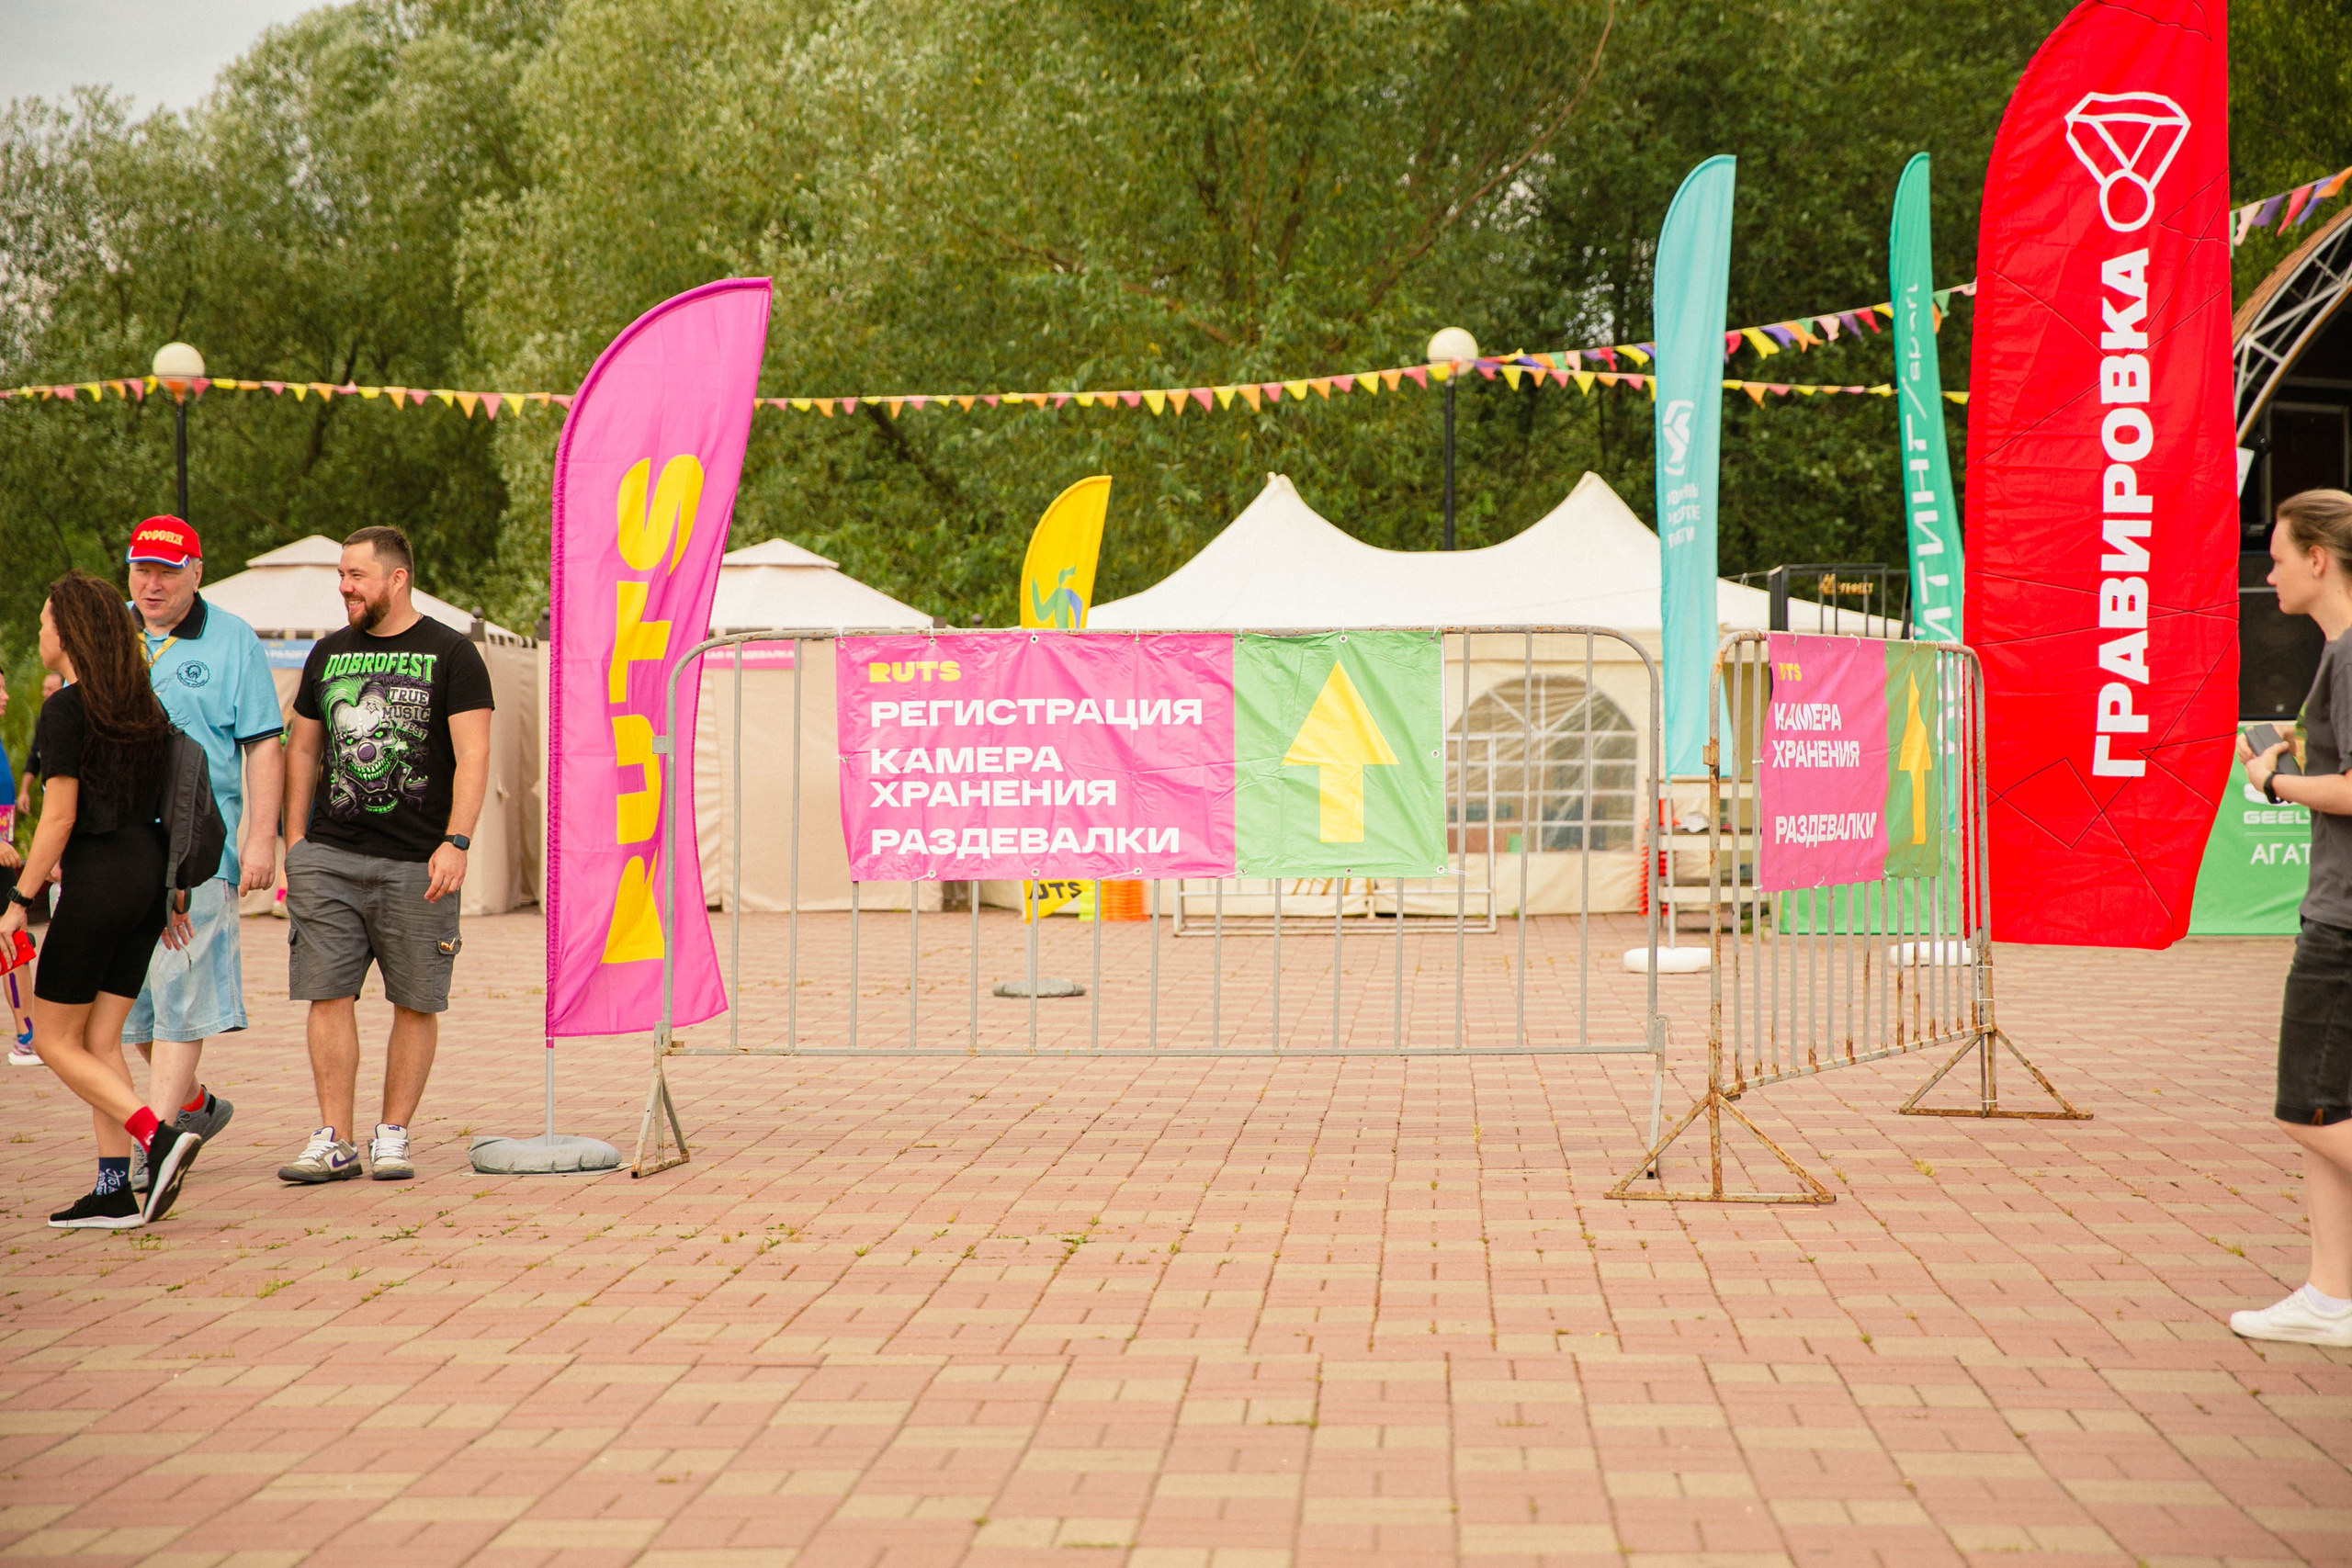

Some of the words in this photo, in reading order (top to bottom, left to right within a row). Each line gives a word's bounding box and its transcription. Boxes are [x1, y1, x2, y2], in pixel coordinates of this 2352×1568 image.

[2092, 248, 2154, 776] ГРАВИРОВКА
[136, 529, 184, 547] РОССИЯ
[321, 651, 437, 683] DOBROFEST
[868, 660, 962, 683] RUTS
[390, 687, 429, 705] TRUE
[382, 705, 431, 722] MUSIC
[870, 698, 1203, 731] РЕГИСТРАЦИЯ
[1774, 702, 1842, 731] КАМЕРА
[401, 721, 428, 739] FEST
[870, 746, 1064, 774] КАМЕРА
[1771, 739, 1860, 769] ХРАНЕНИЯ
[869, 779, 1116, 807] ХРАНЕНИЯ
[871, 827, 1180, 860] РАЗДЕВАЛКИ
[1775, 812, 1878, 849] РАЗДЕВАЛКИ
[2249, 843, 2312, 865] АГАТ
